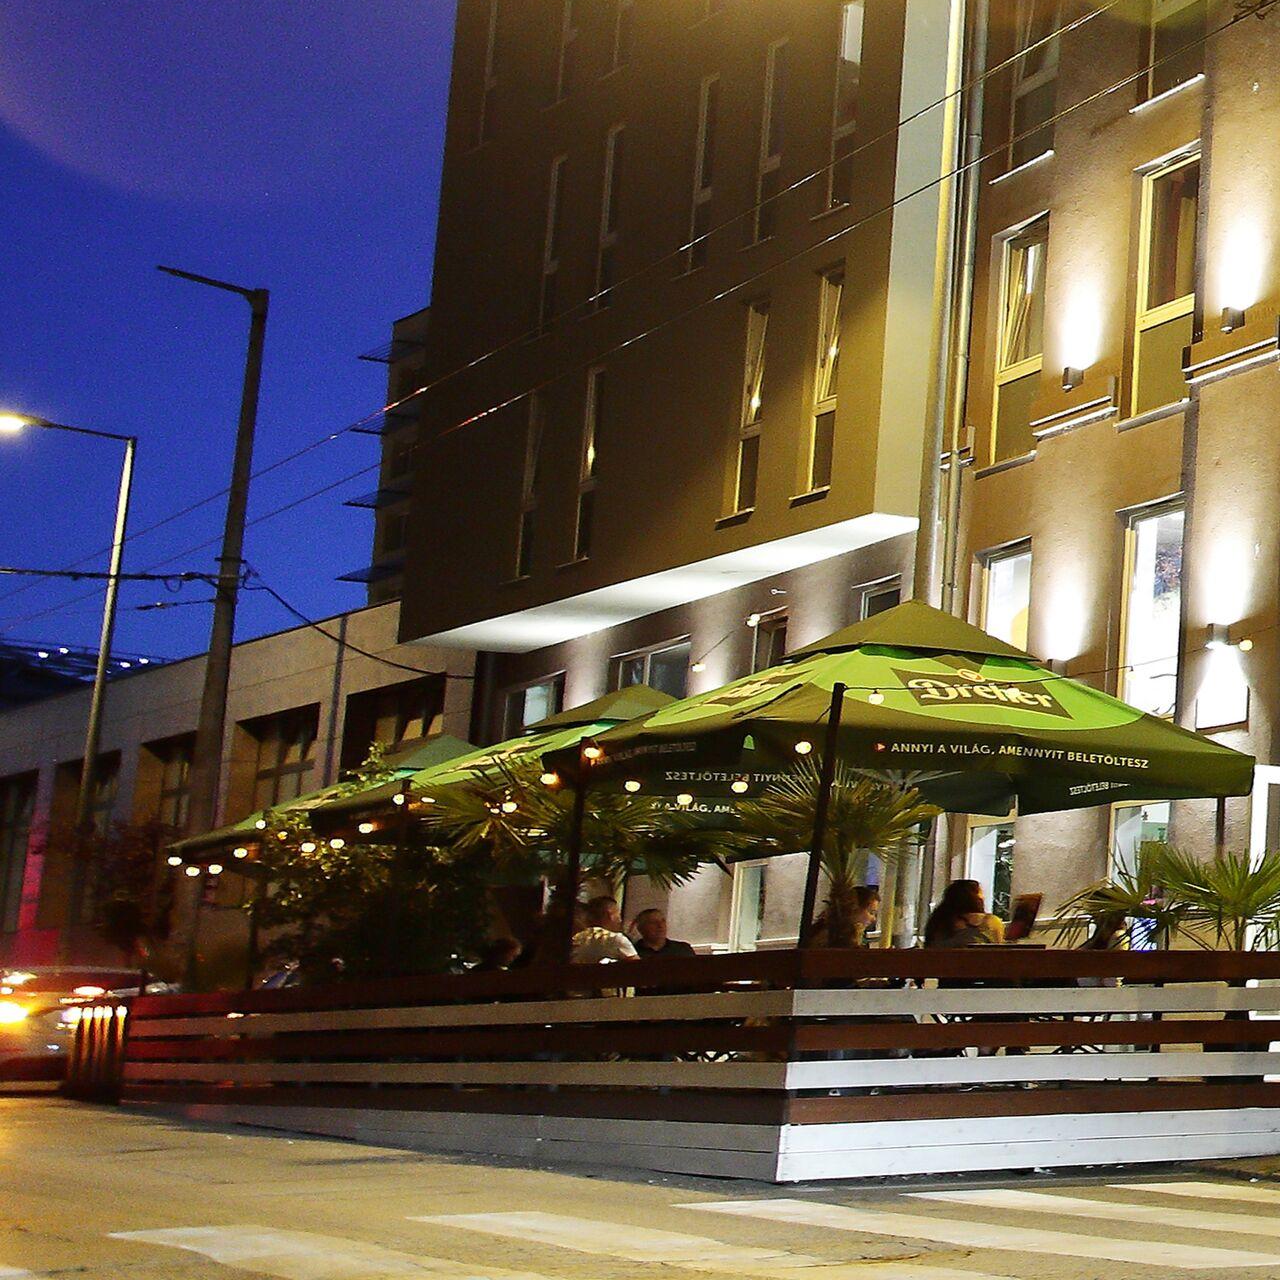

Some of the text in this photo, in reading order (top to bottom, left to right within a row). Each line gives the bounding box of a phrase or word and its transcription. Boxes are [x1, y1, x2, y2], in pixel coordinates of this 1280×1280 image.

[908, 677, 1053, 709] Dreher
[890, 742, 1150, 769] ANNYI A VILÁG, AMENNYIT BELETÖLTESZ
